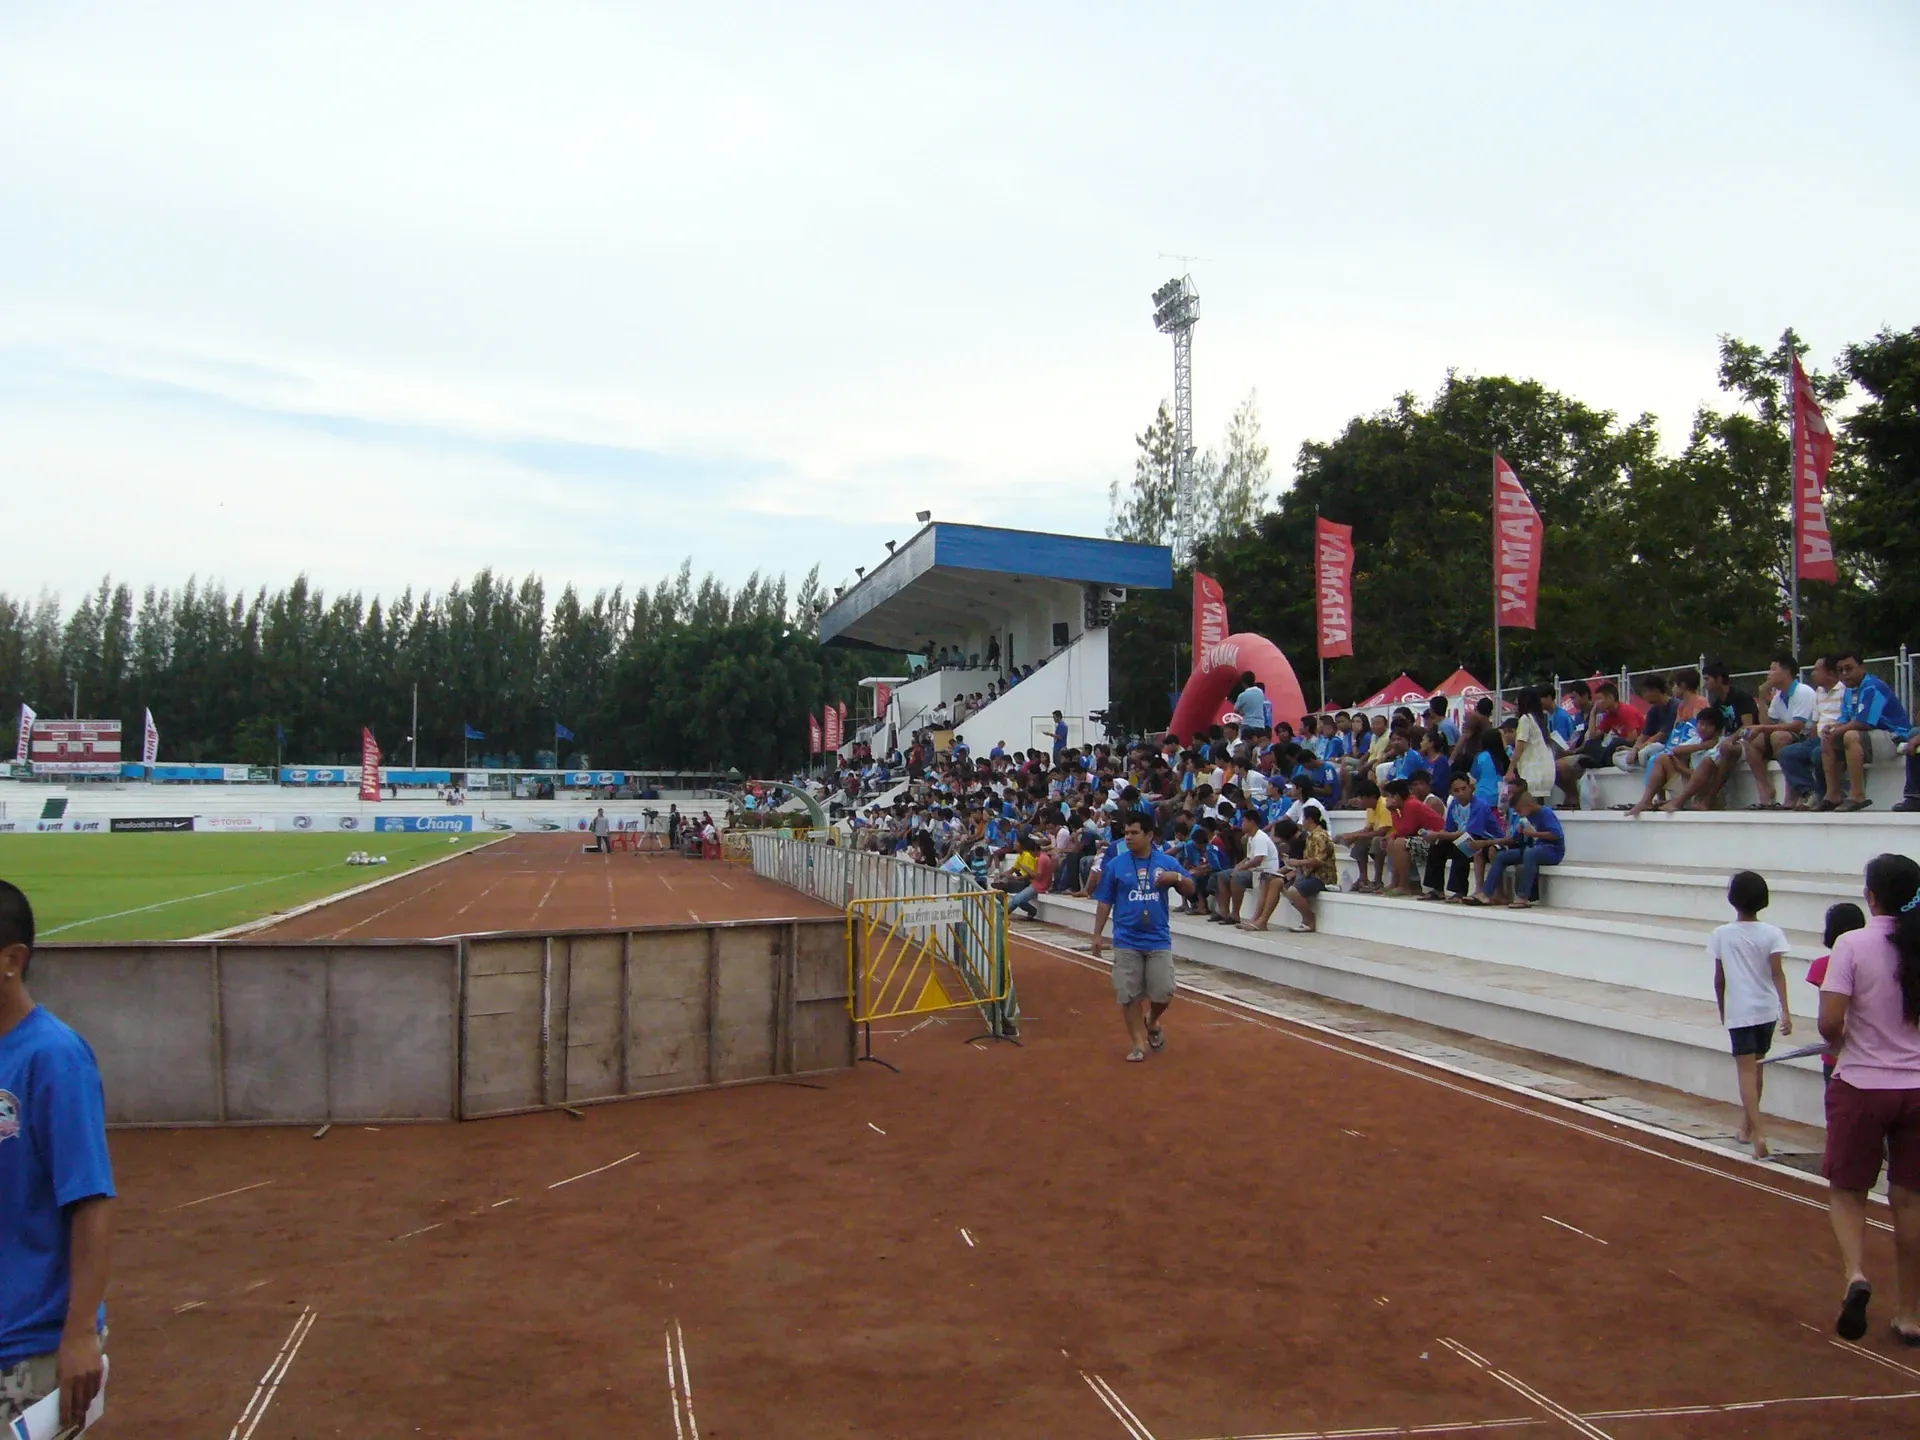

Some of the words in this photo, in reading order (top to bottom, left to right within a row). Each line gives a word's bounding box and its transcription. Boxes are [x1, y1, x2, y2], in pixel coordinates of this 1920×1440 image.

[1500, 471, 1534, 612] YAMAHA
[1320, 532, 1347, 645] YAMAHA
[1201, 602, 1222, 659] YAMA
[47, 823, 63, 831] ptt
[82, 822, 99, 831] ptt
[221, 818, 252, 826] TOYOTA
[415, 816, 464, 832] Chang
[625, 819, 639, 831] ptt
